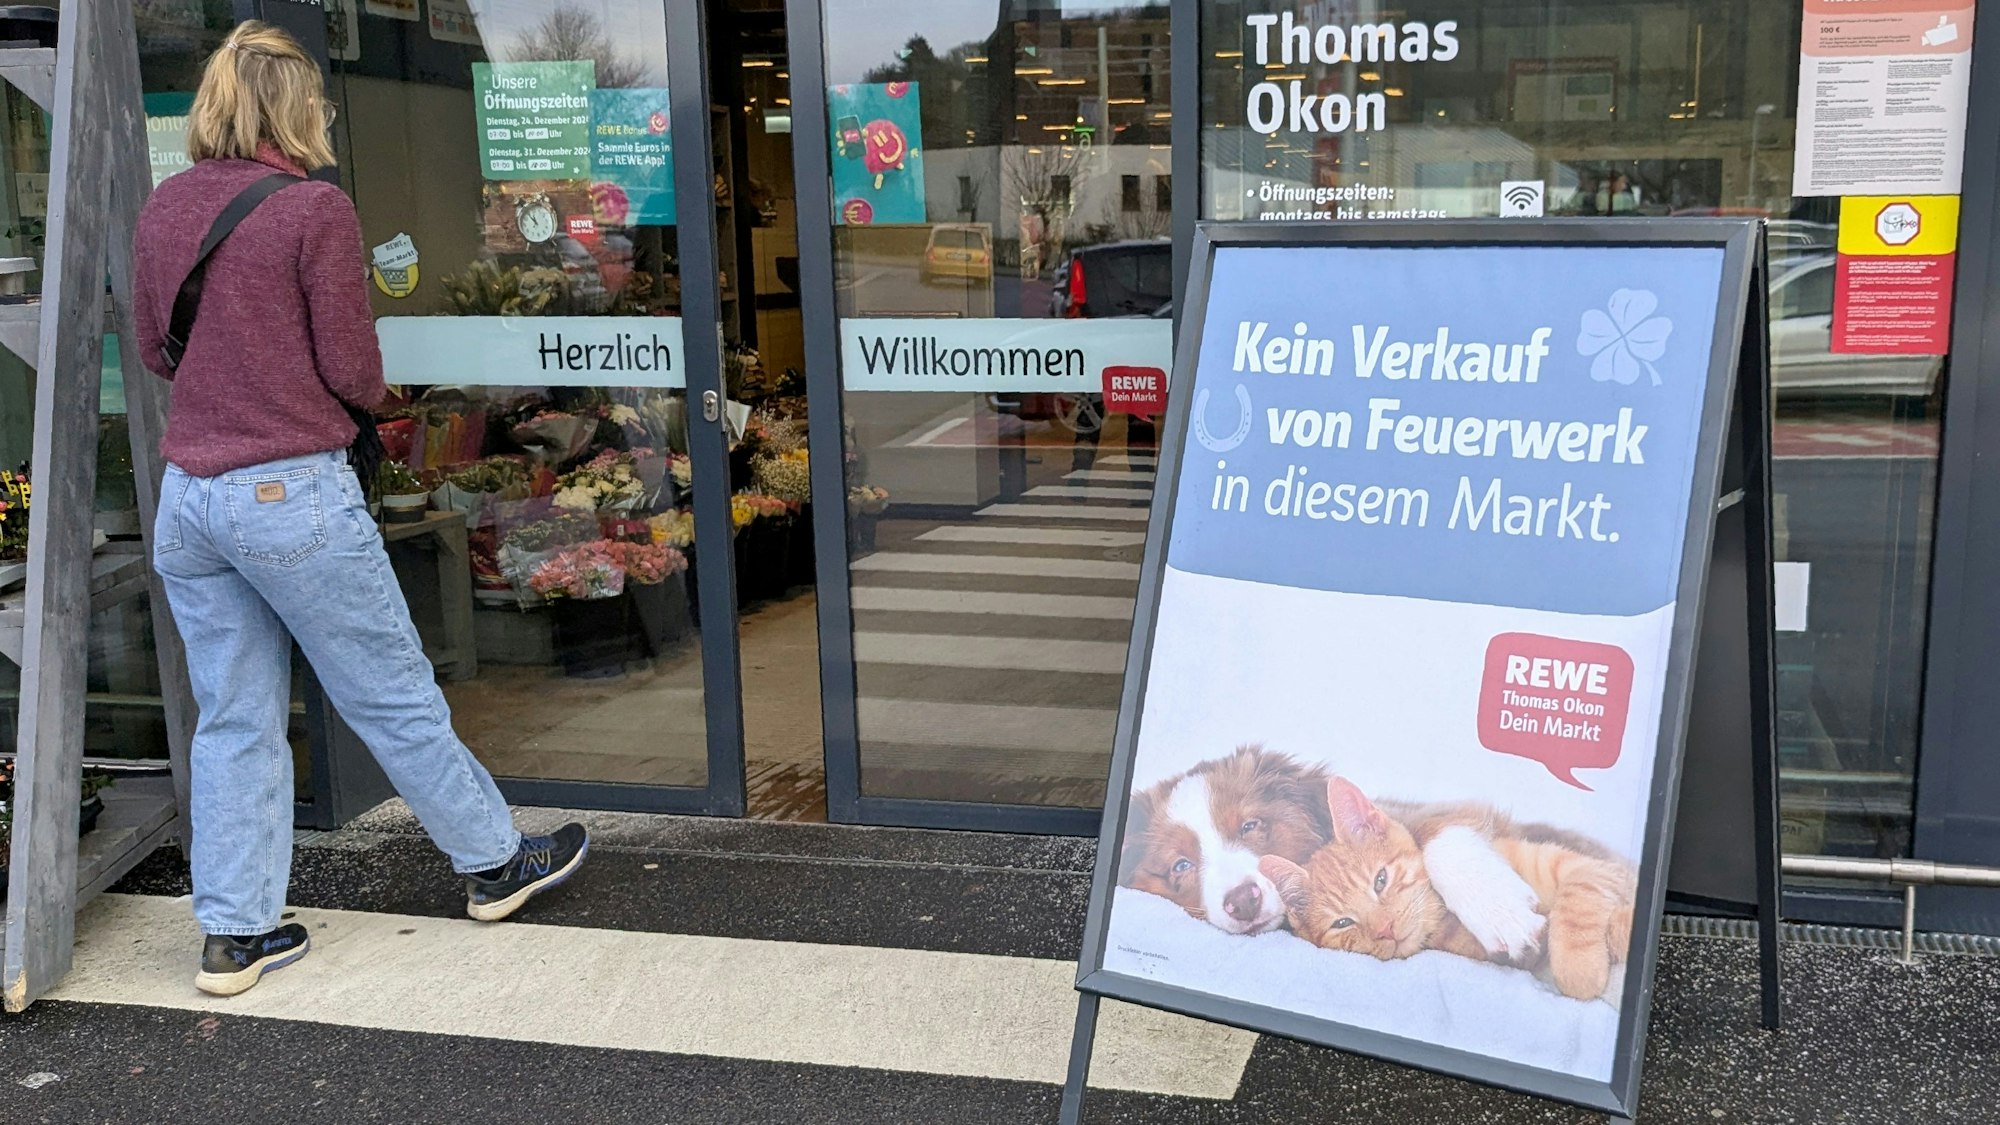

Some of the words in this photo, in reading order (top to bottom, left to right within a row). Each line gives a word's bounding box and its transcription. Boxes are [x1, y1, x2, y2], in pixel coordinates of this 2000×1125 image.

[1246, 11, 1460, 65] Thomas
[1820, 26, 1834, 34] 100
[491, 74, 537, 89] Unsere
[484, 90, 589, 113] Öffnungszeiten
[1246, 80, 1387, 134] Okon
[534, 116, 570, 125] Dezember
[596, 125, 622, 135] REWE
[513, 130, 525, 139] bis
[549, 129, 562, 138] Uhr
[523, 148, 535, 156] 31.
[537, 147, 571, 156] Dezember
[598, 142, 633, 153] Sammle
[634, 142, 660, 153] Euros
[661, 142, 670, 152] in
[516, 161, 527, 170] bis
[552, 161, 566, 169] Uhr
[599, 155, 613, 165] der
[615, 154, 643, 165] REWE
[644, 154, 666, 167] App!
[1259, 181, 1395, 204] Öffnungszeiten:
[570, 220, 594, 228] REWE
[538, 333, 671, 371] Herzlich
[858, 336, 1085, 376] Willkommen
[1232, 321, 1335, 377] Kein
[1352, 324, 1552, 383] Verkauf
[1111, 376, 1158, 391] REWE
[1111, 391, 1130, 402] Dein
[1131, 391, 1158, 403] Markt
[1266, 406, 1352, 449] von
[1365, 397, 1649, 465] Feuerwerk
[1211, 460, 1250, 513] in
[1264, 464, 1429, 528] diesem
[1448, 475, 1620, 543] Markt.
[1505, 654, 1610, 696] REWE
[1502, 689, 1560, 711] Thomas
[1563, 697, 1605, 717] Okon
[1500, 709, 1538, 733] Dein
[1543, 715, 1601, 742] Markt
